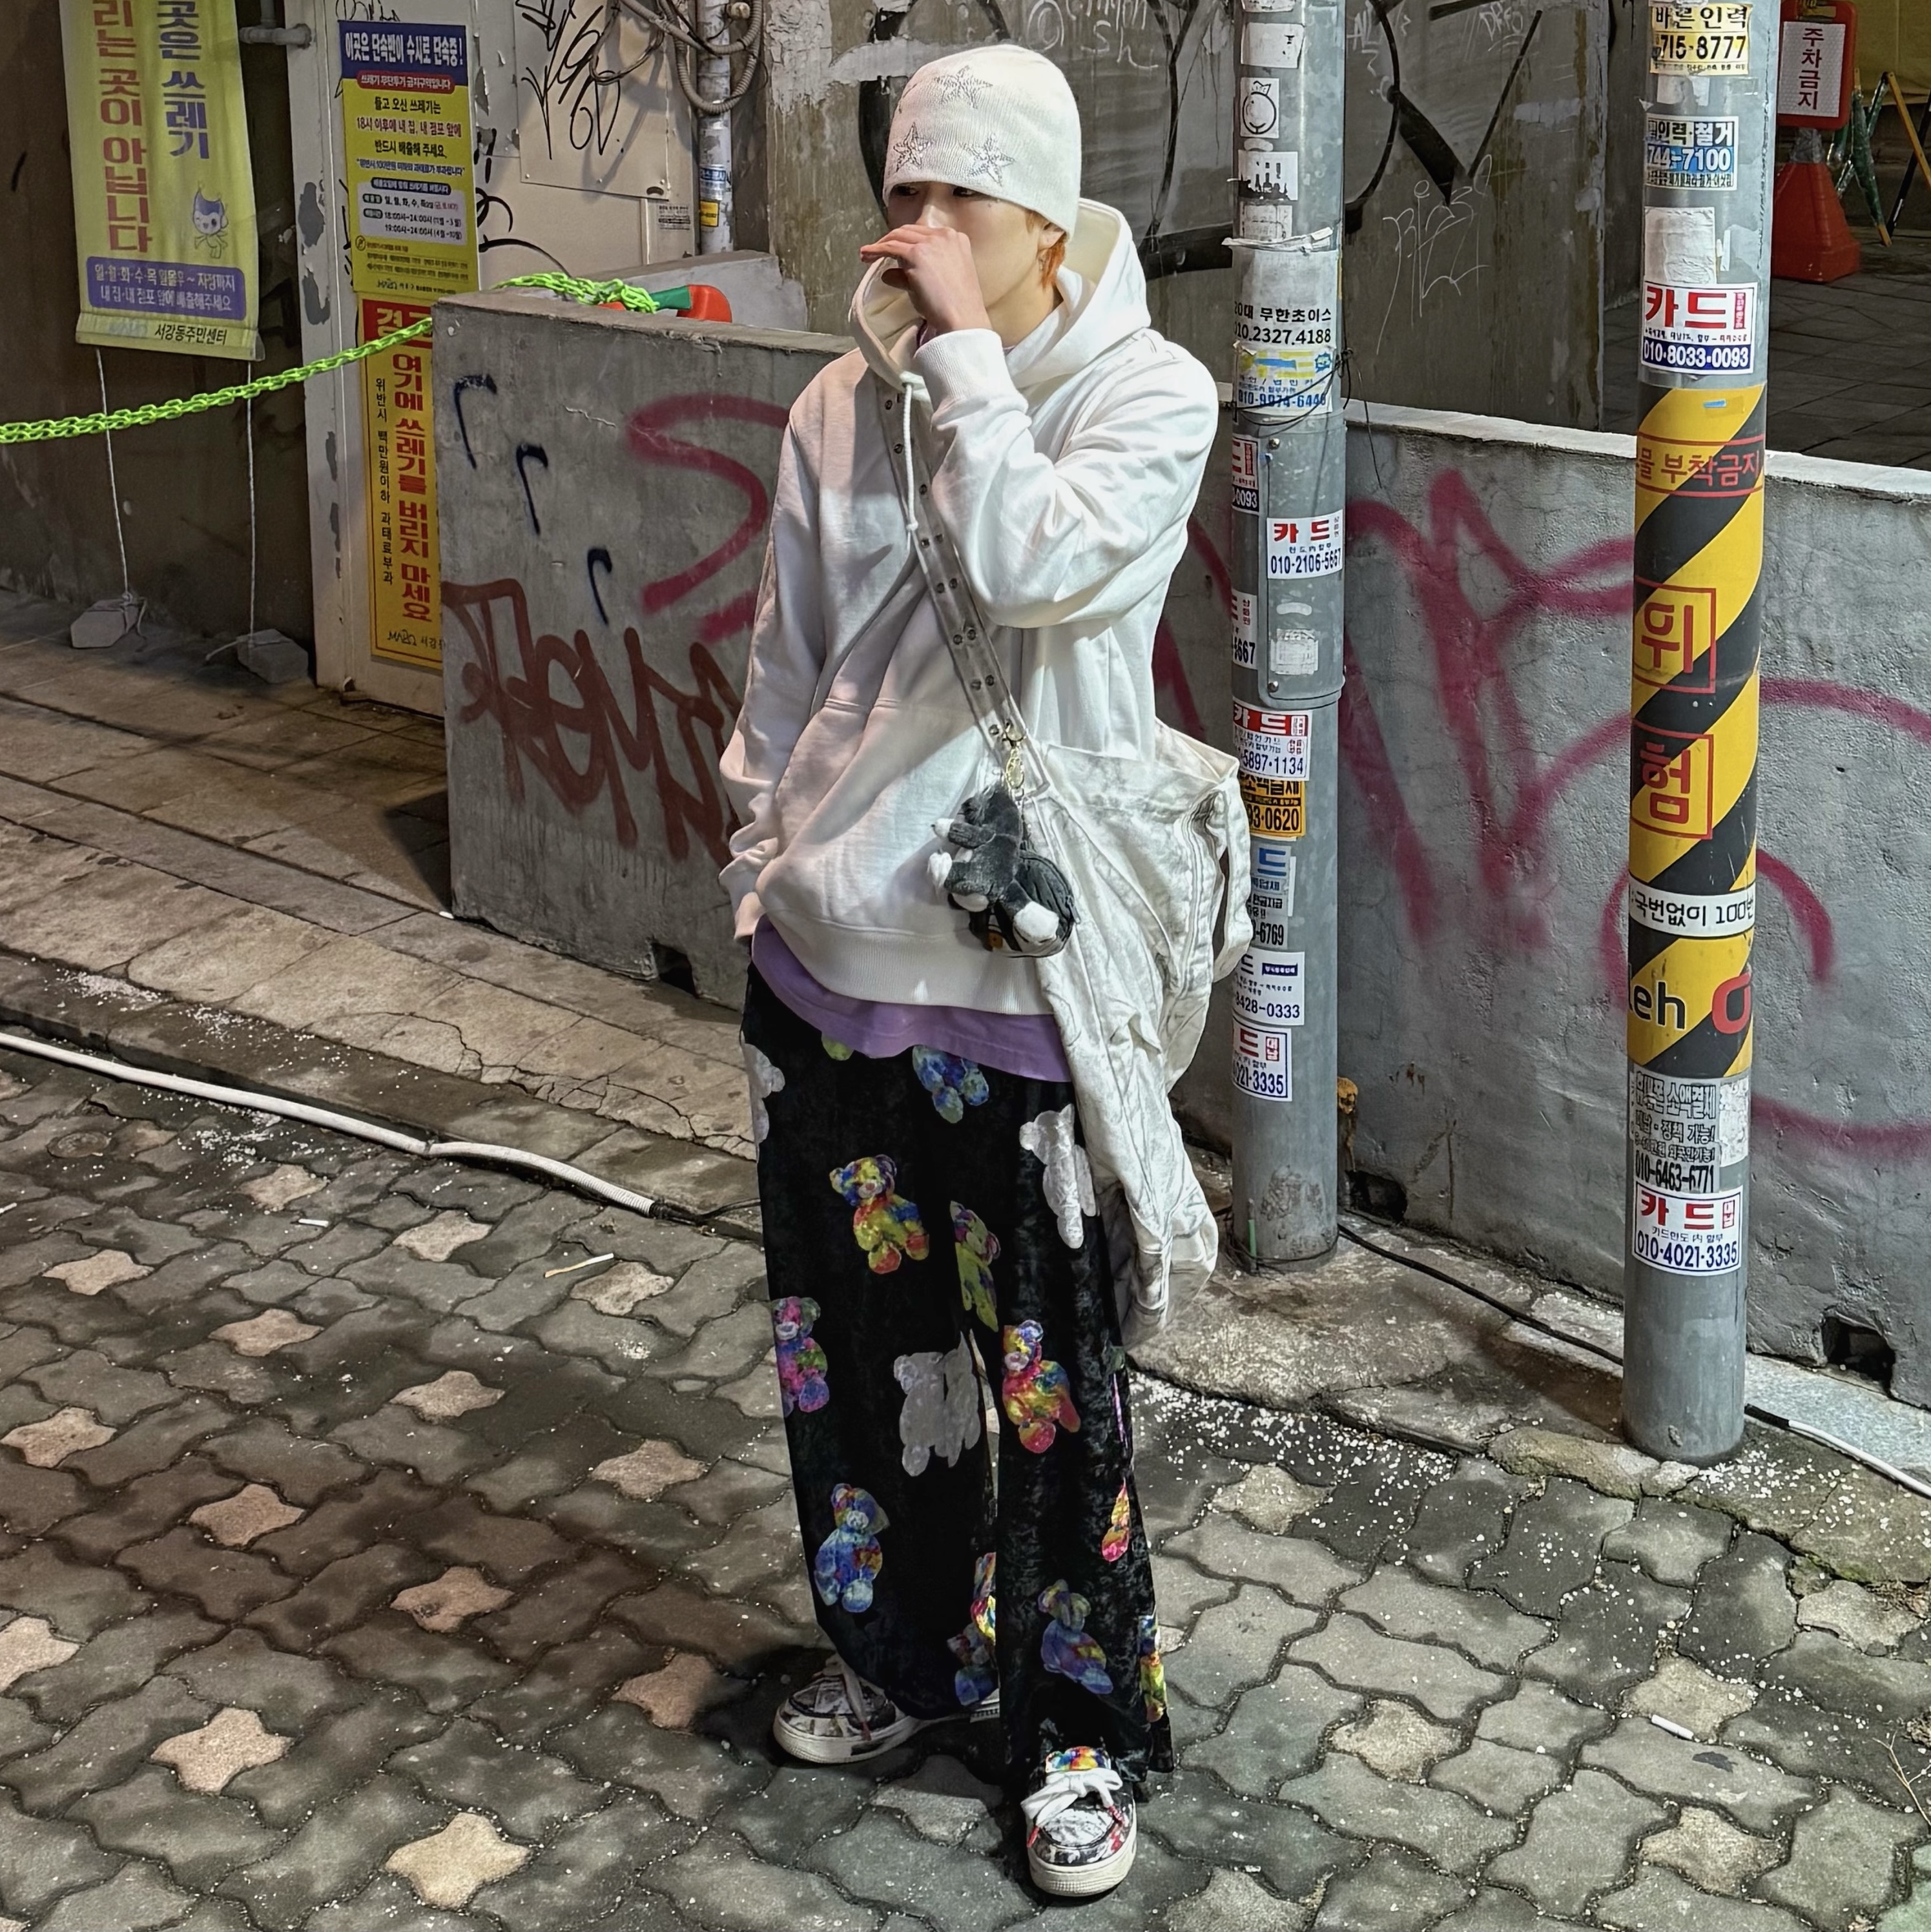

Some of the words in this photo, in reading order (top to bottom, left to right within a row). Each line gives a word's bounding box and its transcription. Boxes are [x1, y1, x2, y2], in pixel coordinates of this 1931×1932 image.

[345, 32, 370, 61] 이곳은
[371, 34, 405, 63] 단속반이
[406, 35, 431, 64] 수시로
[433, 36, 463, 67] 단속중!
[1797, 27, 1825, 110] 주차금지
[99, 68, 143, 127] 곳이
[161, 70, 210, 159] 쓰레기
[375, 96, 390, 110] 들고
[392, 98, 408, 112] 오신
[409, 99, 441, 114] 쓰레기는
[356, 117, 373, 131] 18시
[375, 139, 397, 154] 반드시
[1648, 146, 1731, 172] 744-7100
[103, 137, 152, 253] 아닙니다
[1259, 307, 1332, 323] 무한초이스
[1645, 285, 1727, 329] 카드
[154, 324, 228, 345] 서강동주민센터
[376, 378, 387, 422] 위반시
[393, 354, 424, 411] 여기에
[395, 418, 427, 495] 쓰레기를
[1660, 449, 1760, 488] 부착금지
[398, 500, 429, 558] 버리지
[1274, 519, 1330, 544] 카드
[401, 563, 433, 622] 마세요
[1234, 704, 1286, 735] 카드
[1635, 890, 1707, 928] 국번없이
[1666, 1082, 1717, 1120] 소액결제
[1640, 1189, 1715, 1230] 카드
